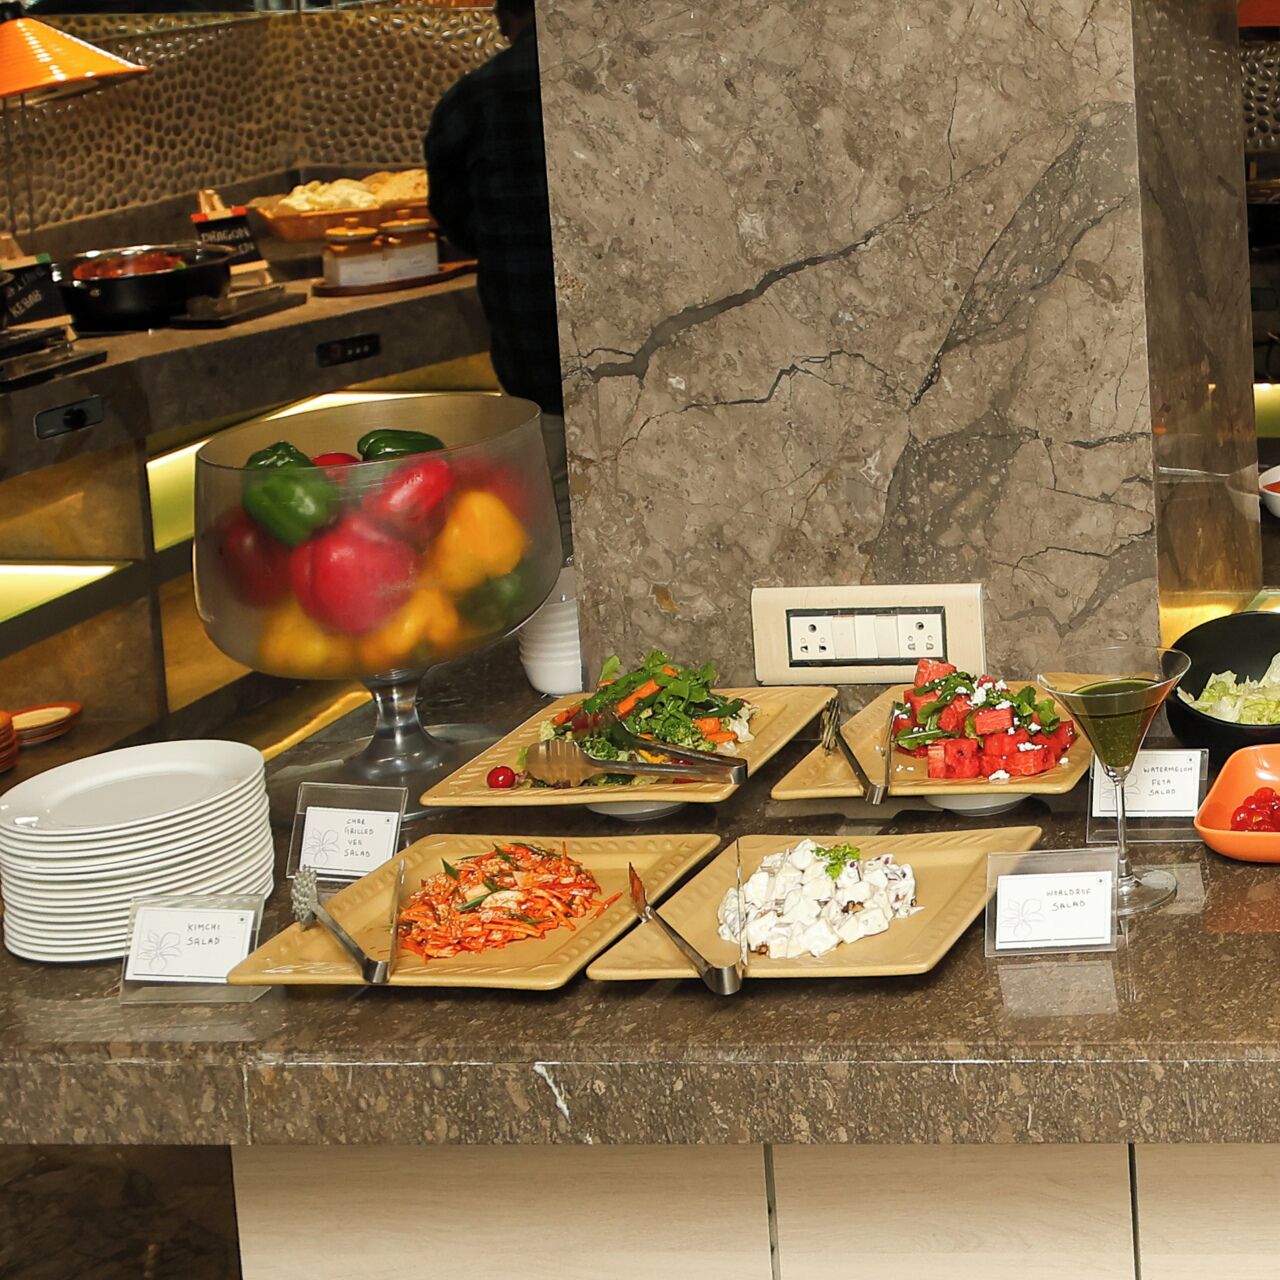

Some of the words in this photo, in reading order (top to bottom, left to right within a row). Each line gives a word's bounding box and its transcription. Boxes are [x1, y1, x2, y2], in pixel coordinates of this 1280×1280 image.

[200, 227, 251, 243] DRAGON
[1143, 765, 1193, 773] WATERMELON
[1151, 778, 1172, 786] FETA
[1148, 787, 1176, 796] SALAD
[344, 826, 375, 836] GRILLED
[343, 848, 371, 858] SALAD
[1051, 901, 1087, 911] SALAD
[186, 922, 222, 932] KIMCHI
[185, 935, 221, 947] SALAD
